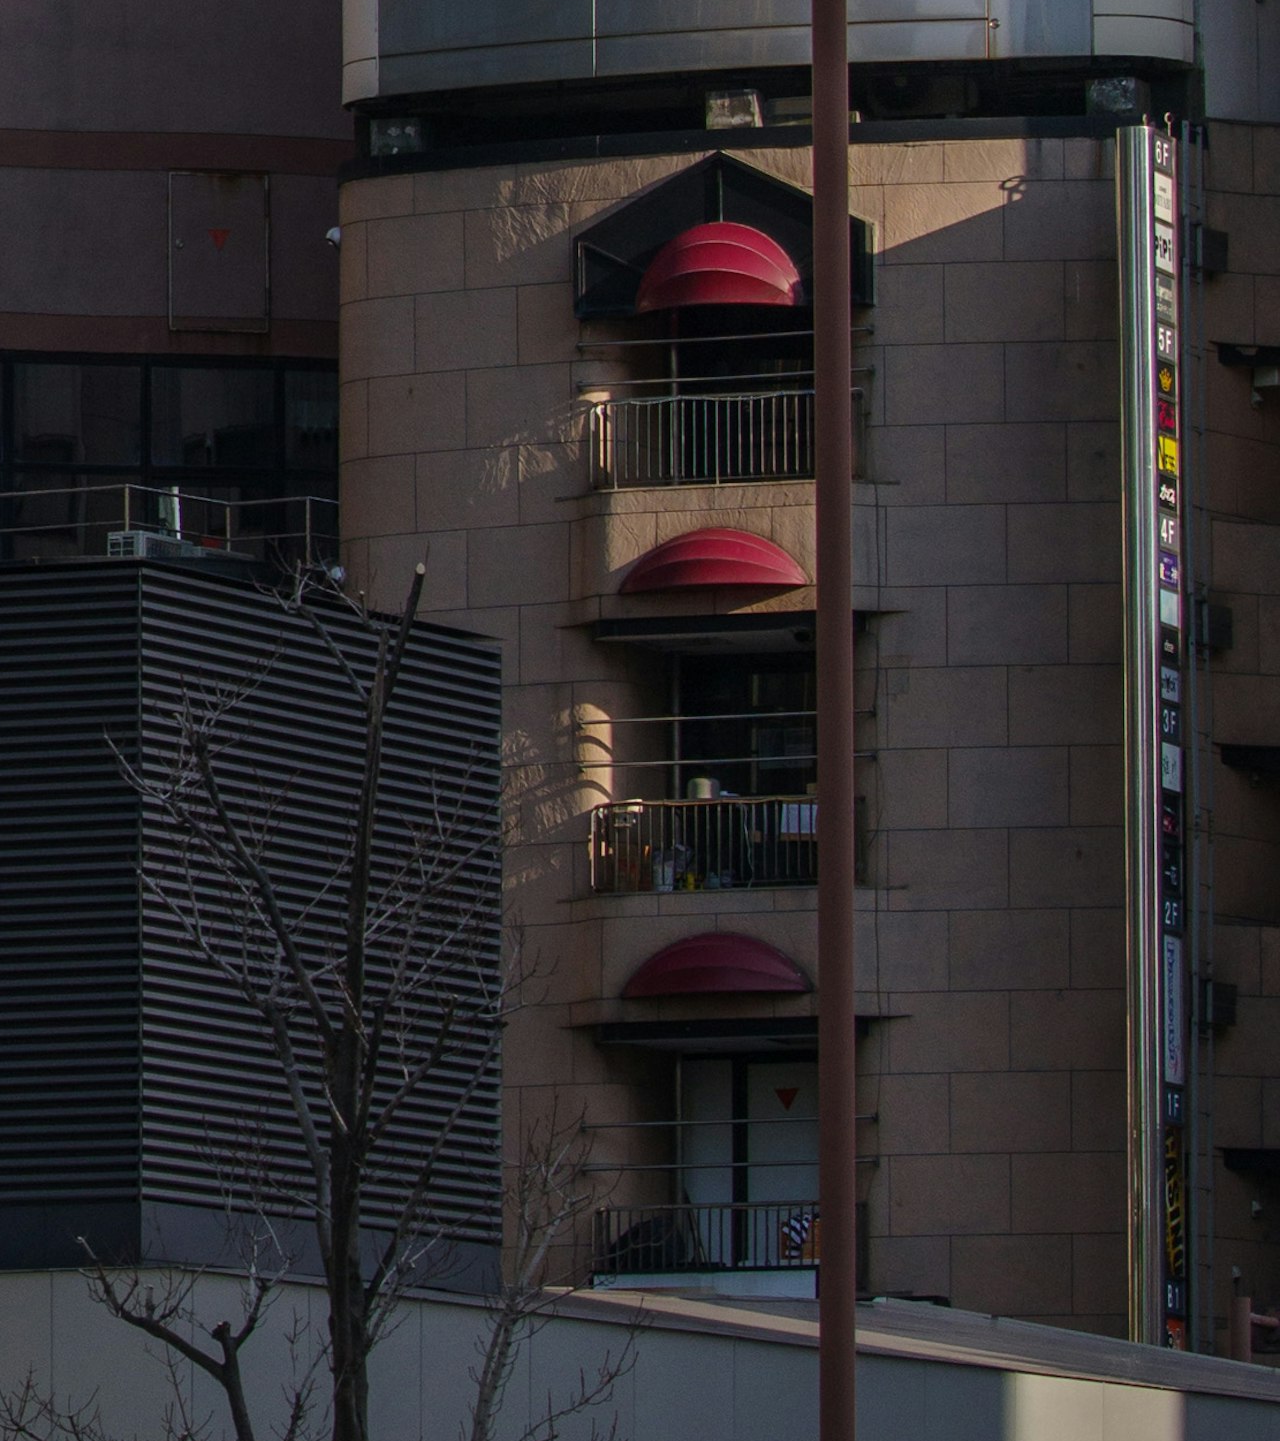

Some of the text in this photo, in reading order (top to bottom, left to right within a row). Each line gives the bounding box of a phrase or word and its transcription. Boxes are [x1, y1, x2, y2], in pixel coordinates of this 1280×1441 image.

[1155, 140, 1169, 167] 6F
[1158, 327, 1172, 354] 5F
[1161, 518, 1175, 544] 4F
[1163, 709, 1176, 735] 3F
[1164, 901, 1178, 927] 2F
[1168, 1093, 1180, 1117] 1F
[1167, 1283, 1180, 1310] B1
